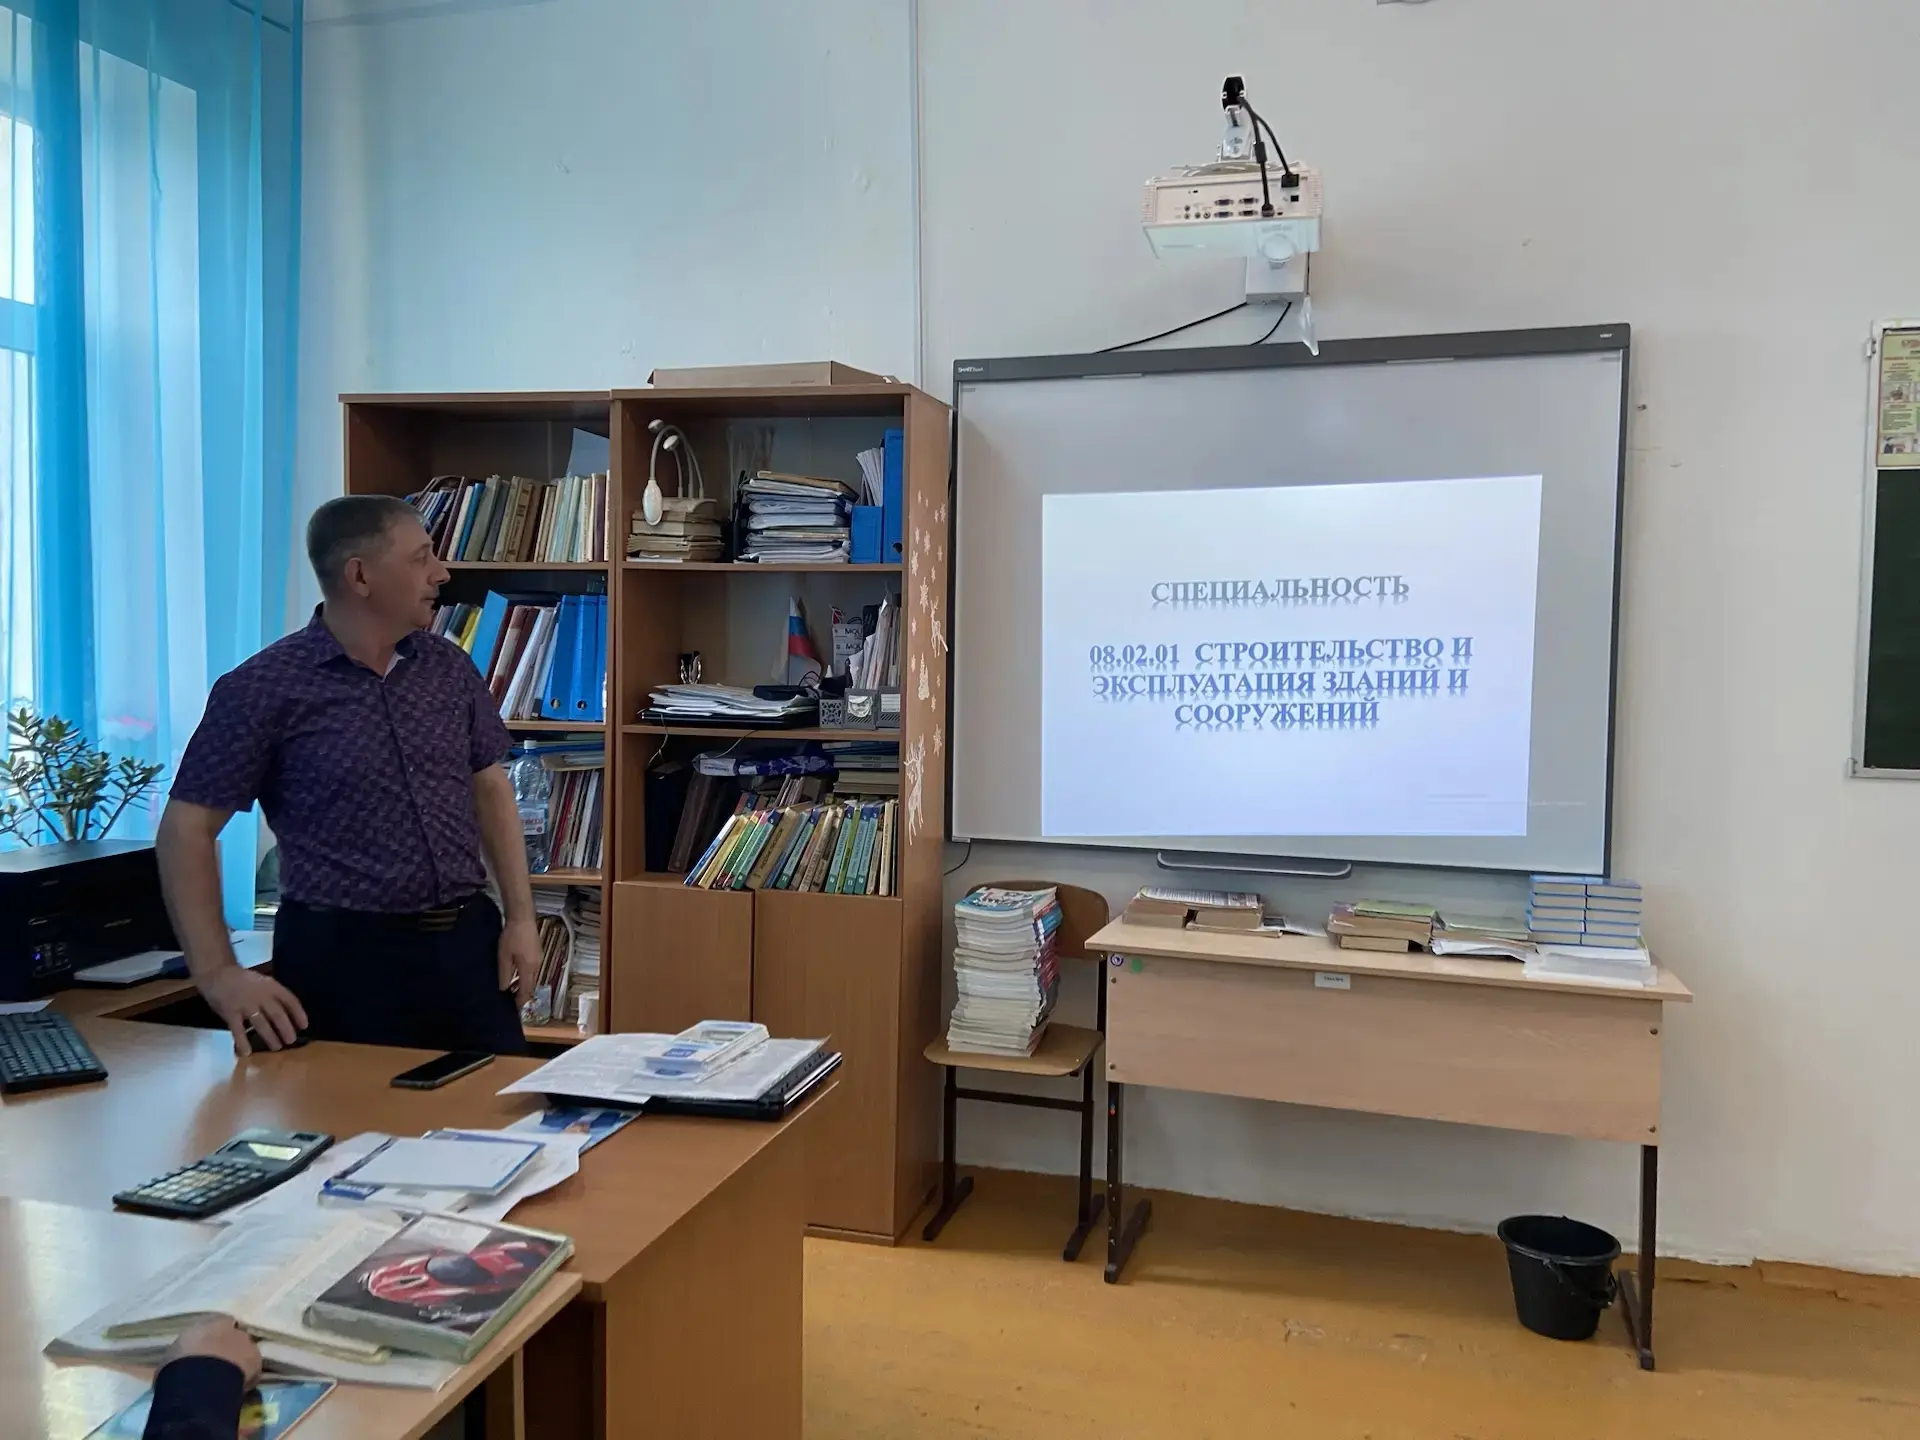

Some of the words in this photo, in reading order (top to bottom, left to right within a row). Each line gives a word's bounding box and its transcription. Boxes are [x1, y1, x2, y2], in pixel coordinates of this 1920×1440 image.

[1151, 576, 1409, 602] СПЕЦИАЛЬНОСТЬ
[1089, 644, 1179, 665] 08.02.01
[1195, 638, 1444, 663] СТРОИТЕЛЬСТВО
[1451, 637, 1473, 657] И
[1092, 672, 1316, 696] ЭКСПЛУАТАЦИЯ
[1323, 664, 1440, 694] ЗДАНИЙ
[1447, 668, 1469, 689] И
[1175, 697, 1380, 725] СООРУЖЕНИЙ
